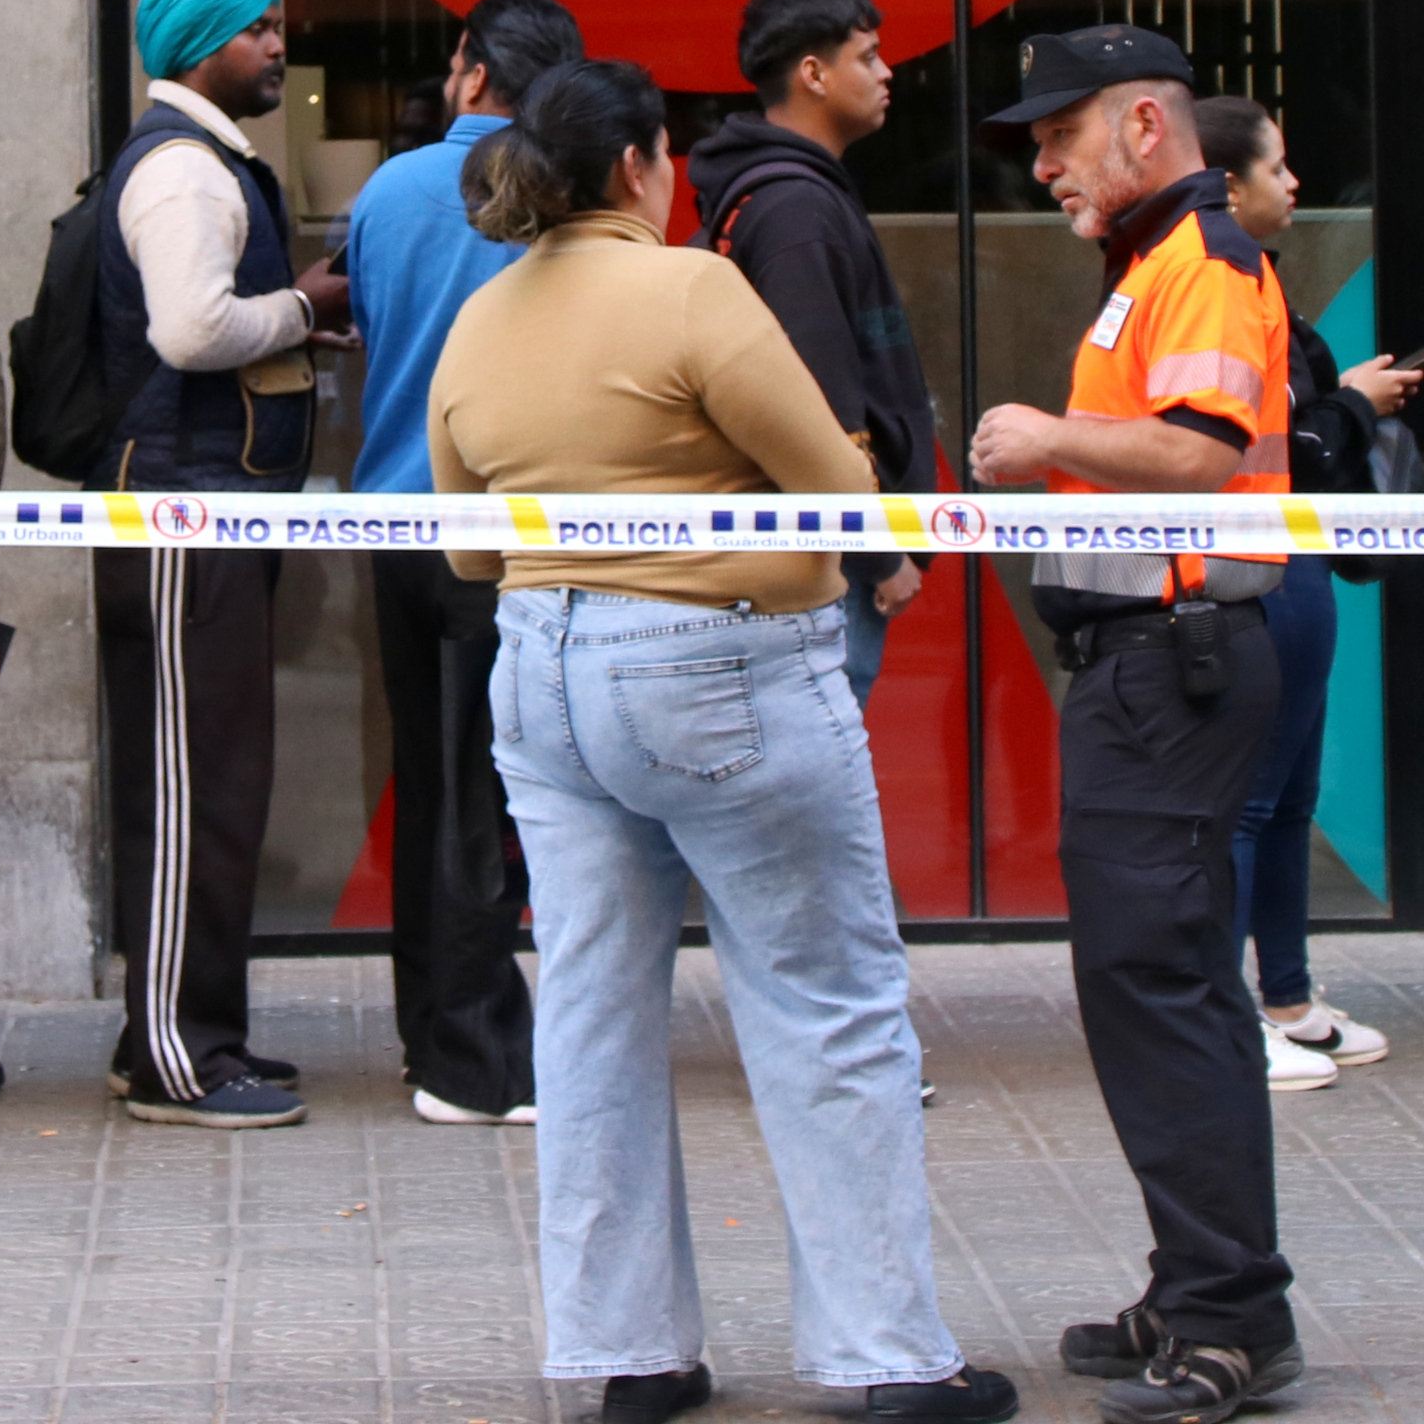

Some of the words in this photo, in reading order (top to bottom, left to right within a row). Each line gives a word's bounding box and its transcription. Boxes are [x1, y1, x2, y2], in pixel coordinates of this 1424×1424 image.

[13, 527, 83, 541] Urbana
[215, 518, 270, 543] NO
[286, 519, 439, 544] PASSEU
[558, 521, 695, 545] POLICIA
[713, 535, 789, 548] Guàrdia
[796, 536, 865, 548] Urbana
[994, 525, 1049, 548] NO
[1065, 526, 1215, 549] PASSEU
